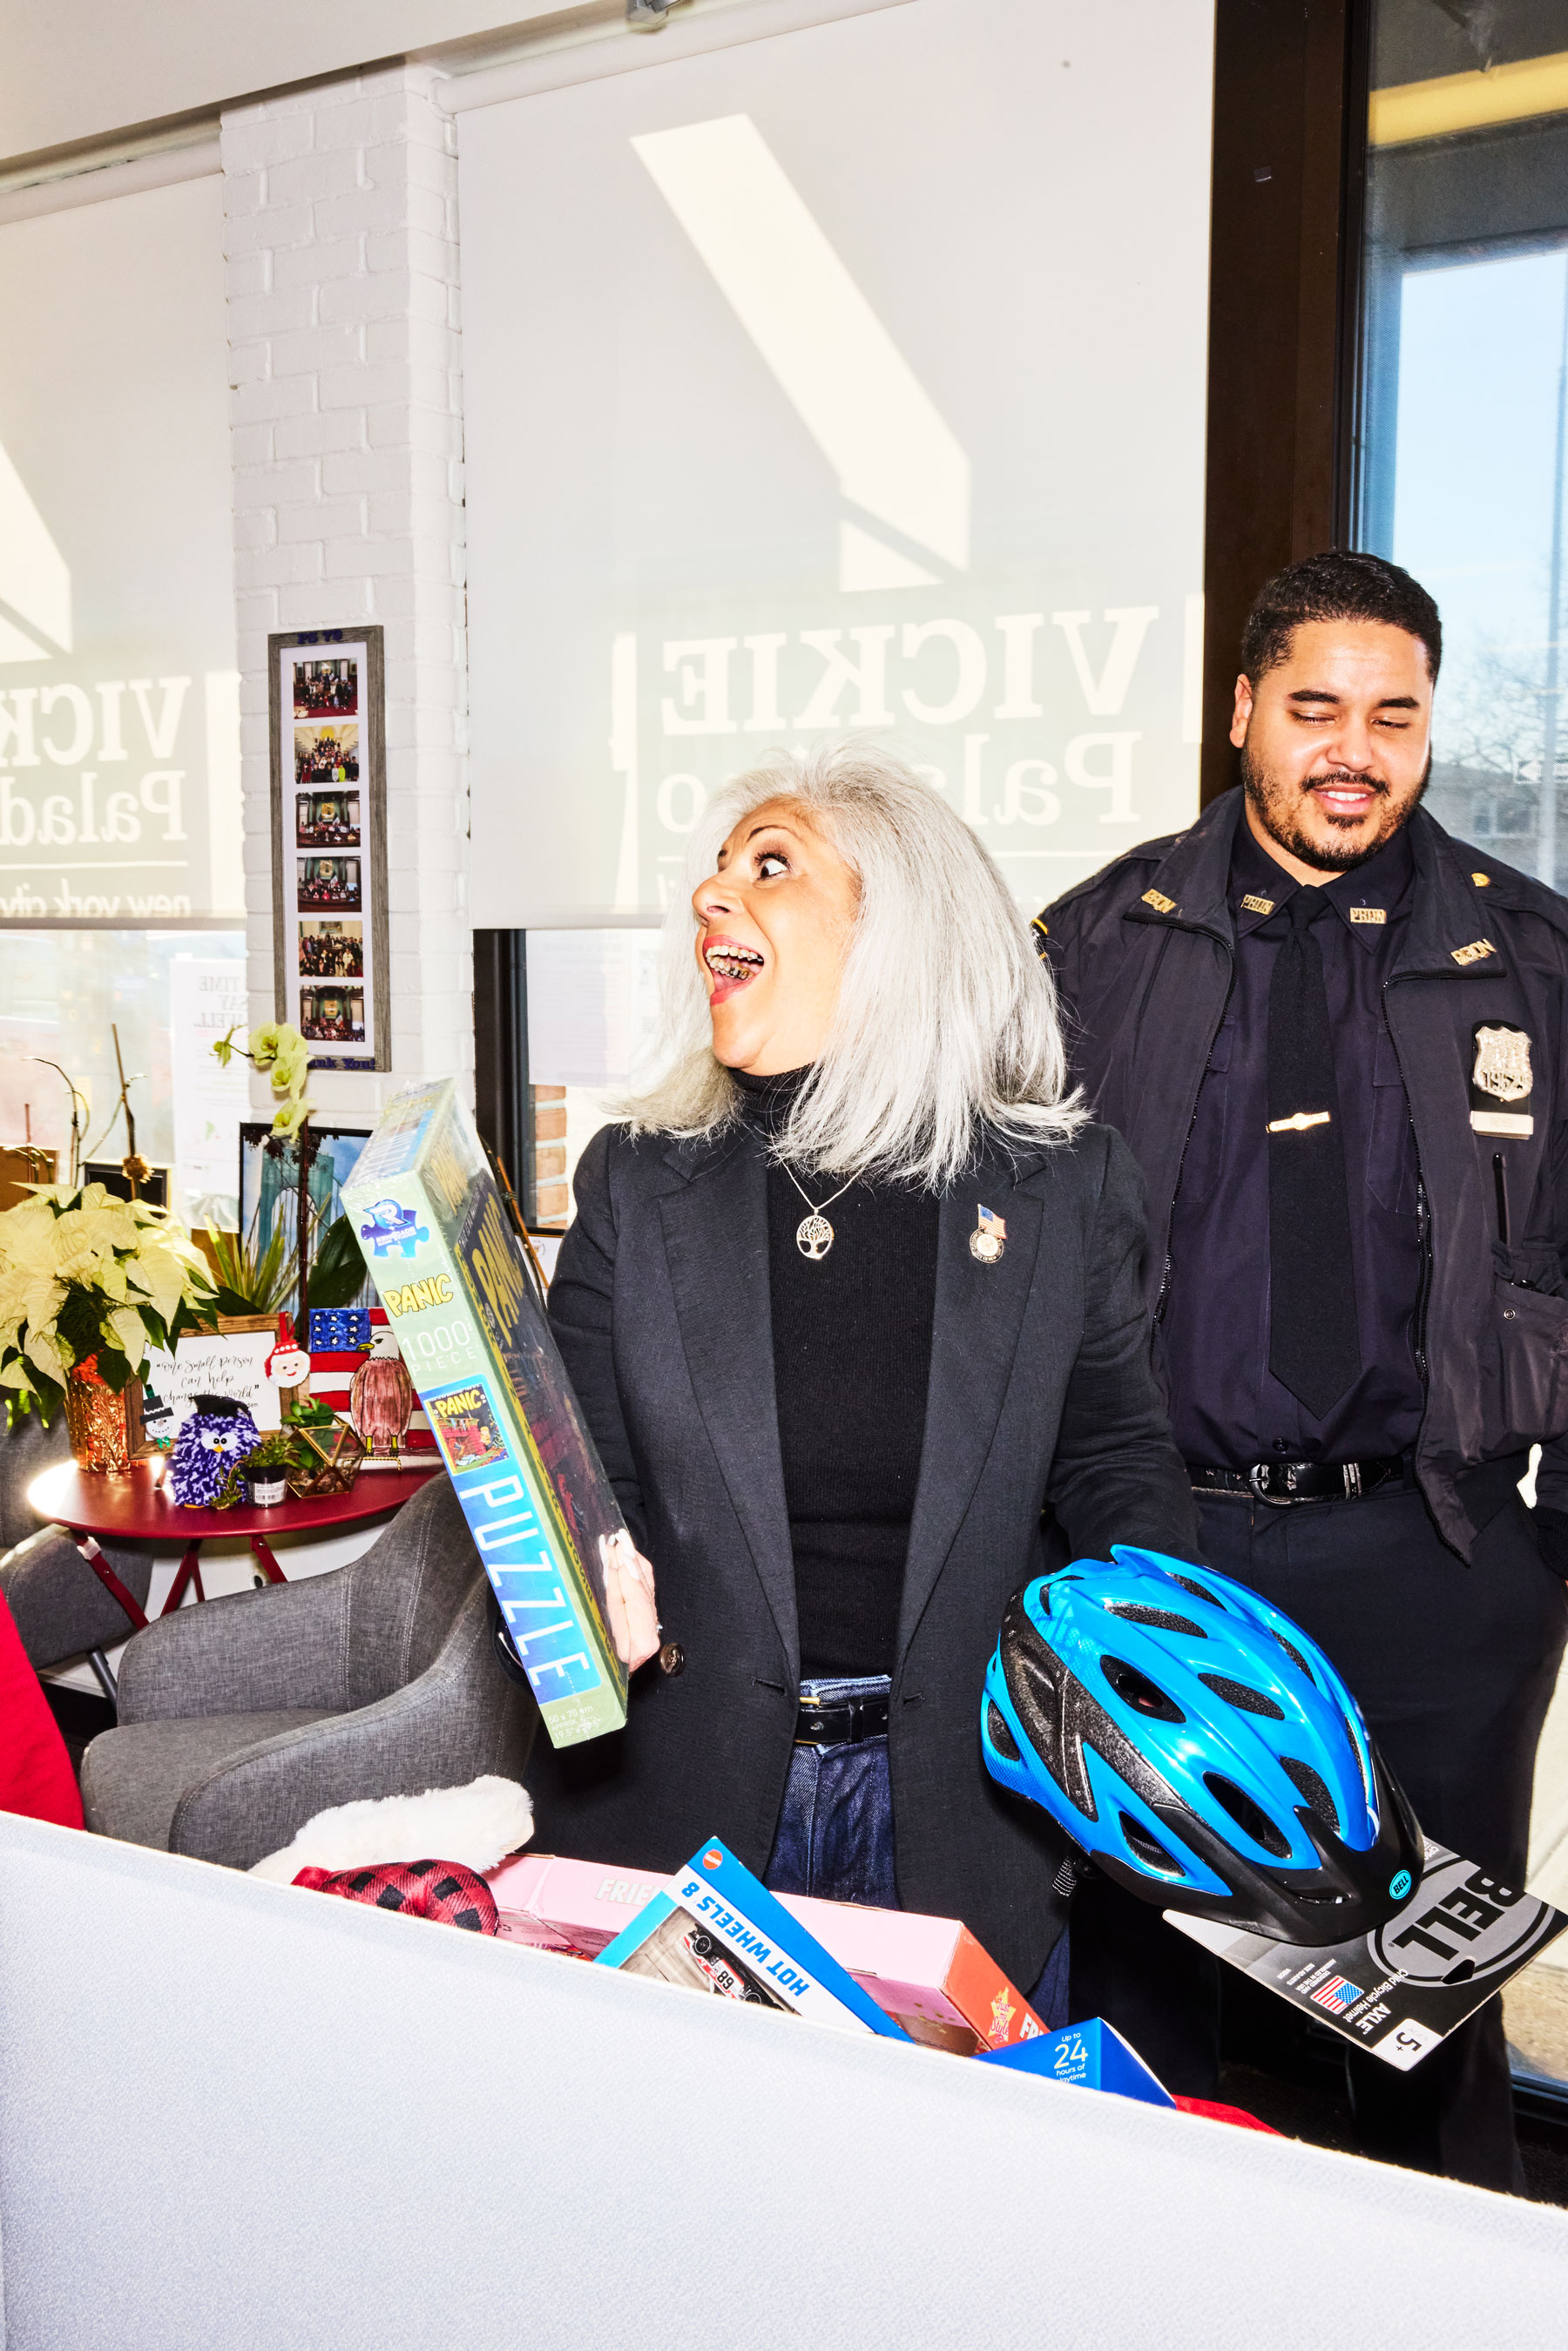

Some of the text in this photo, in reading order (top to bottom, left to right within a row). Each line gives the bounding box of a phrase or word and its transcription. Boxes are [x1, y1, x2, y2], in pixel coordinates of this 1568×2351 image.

[307, 1057, 375, 1071] ank You!
[471, 1192, 524, 1348] PANIC
[383, 1273, 454, 1318] PANIC
[402, 1321, 471, 1361] 1000
[410, 1346, 477, 1376] PIECE
[208, 1370, 234, 1389] help
[435, 1389, 482, 1418] PANIC
[459, 1475, 590, 1686] PUZZLE
[548, 1714, 559, 1725] 50
[594, 1876, 662, 1908] FRIE
[1393, 1876, 1409, 1895] BELL
[1392, 1868, 1528, 1961] BELL
[681, 1881, 810, 1997] HOT WHEELS 8
[1342, 1968, 1409, 2023] Child Bicycle Helmet
[1053, 2039, 1089, 2070] 24
[1056, 2063, 1085, 2077] hours of
[1056, 2072, 1087, 2084] laytime
